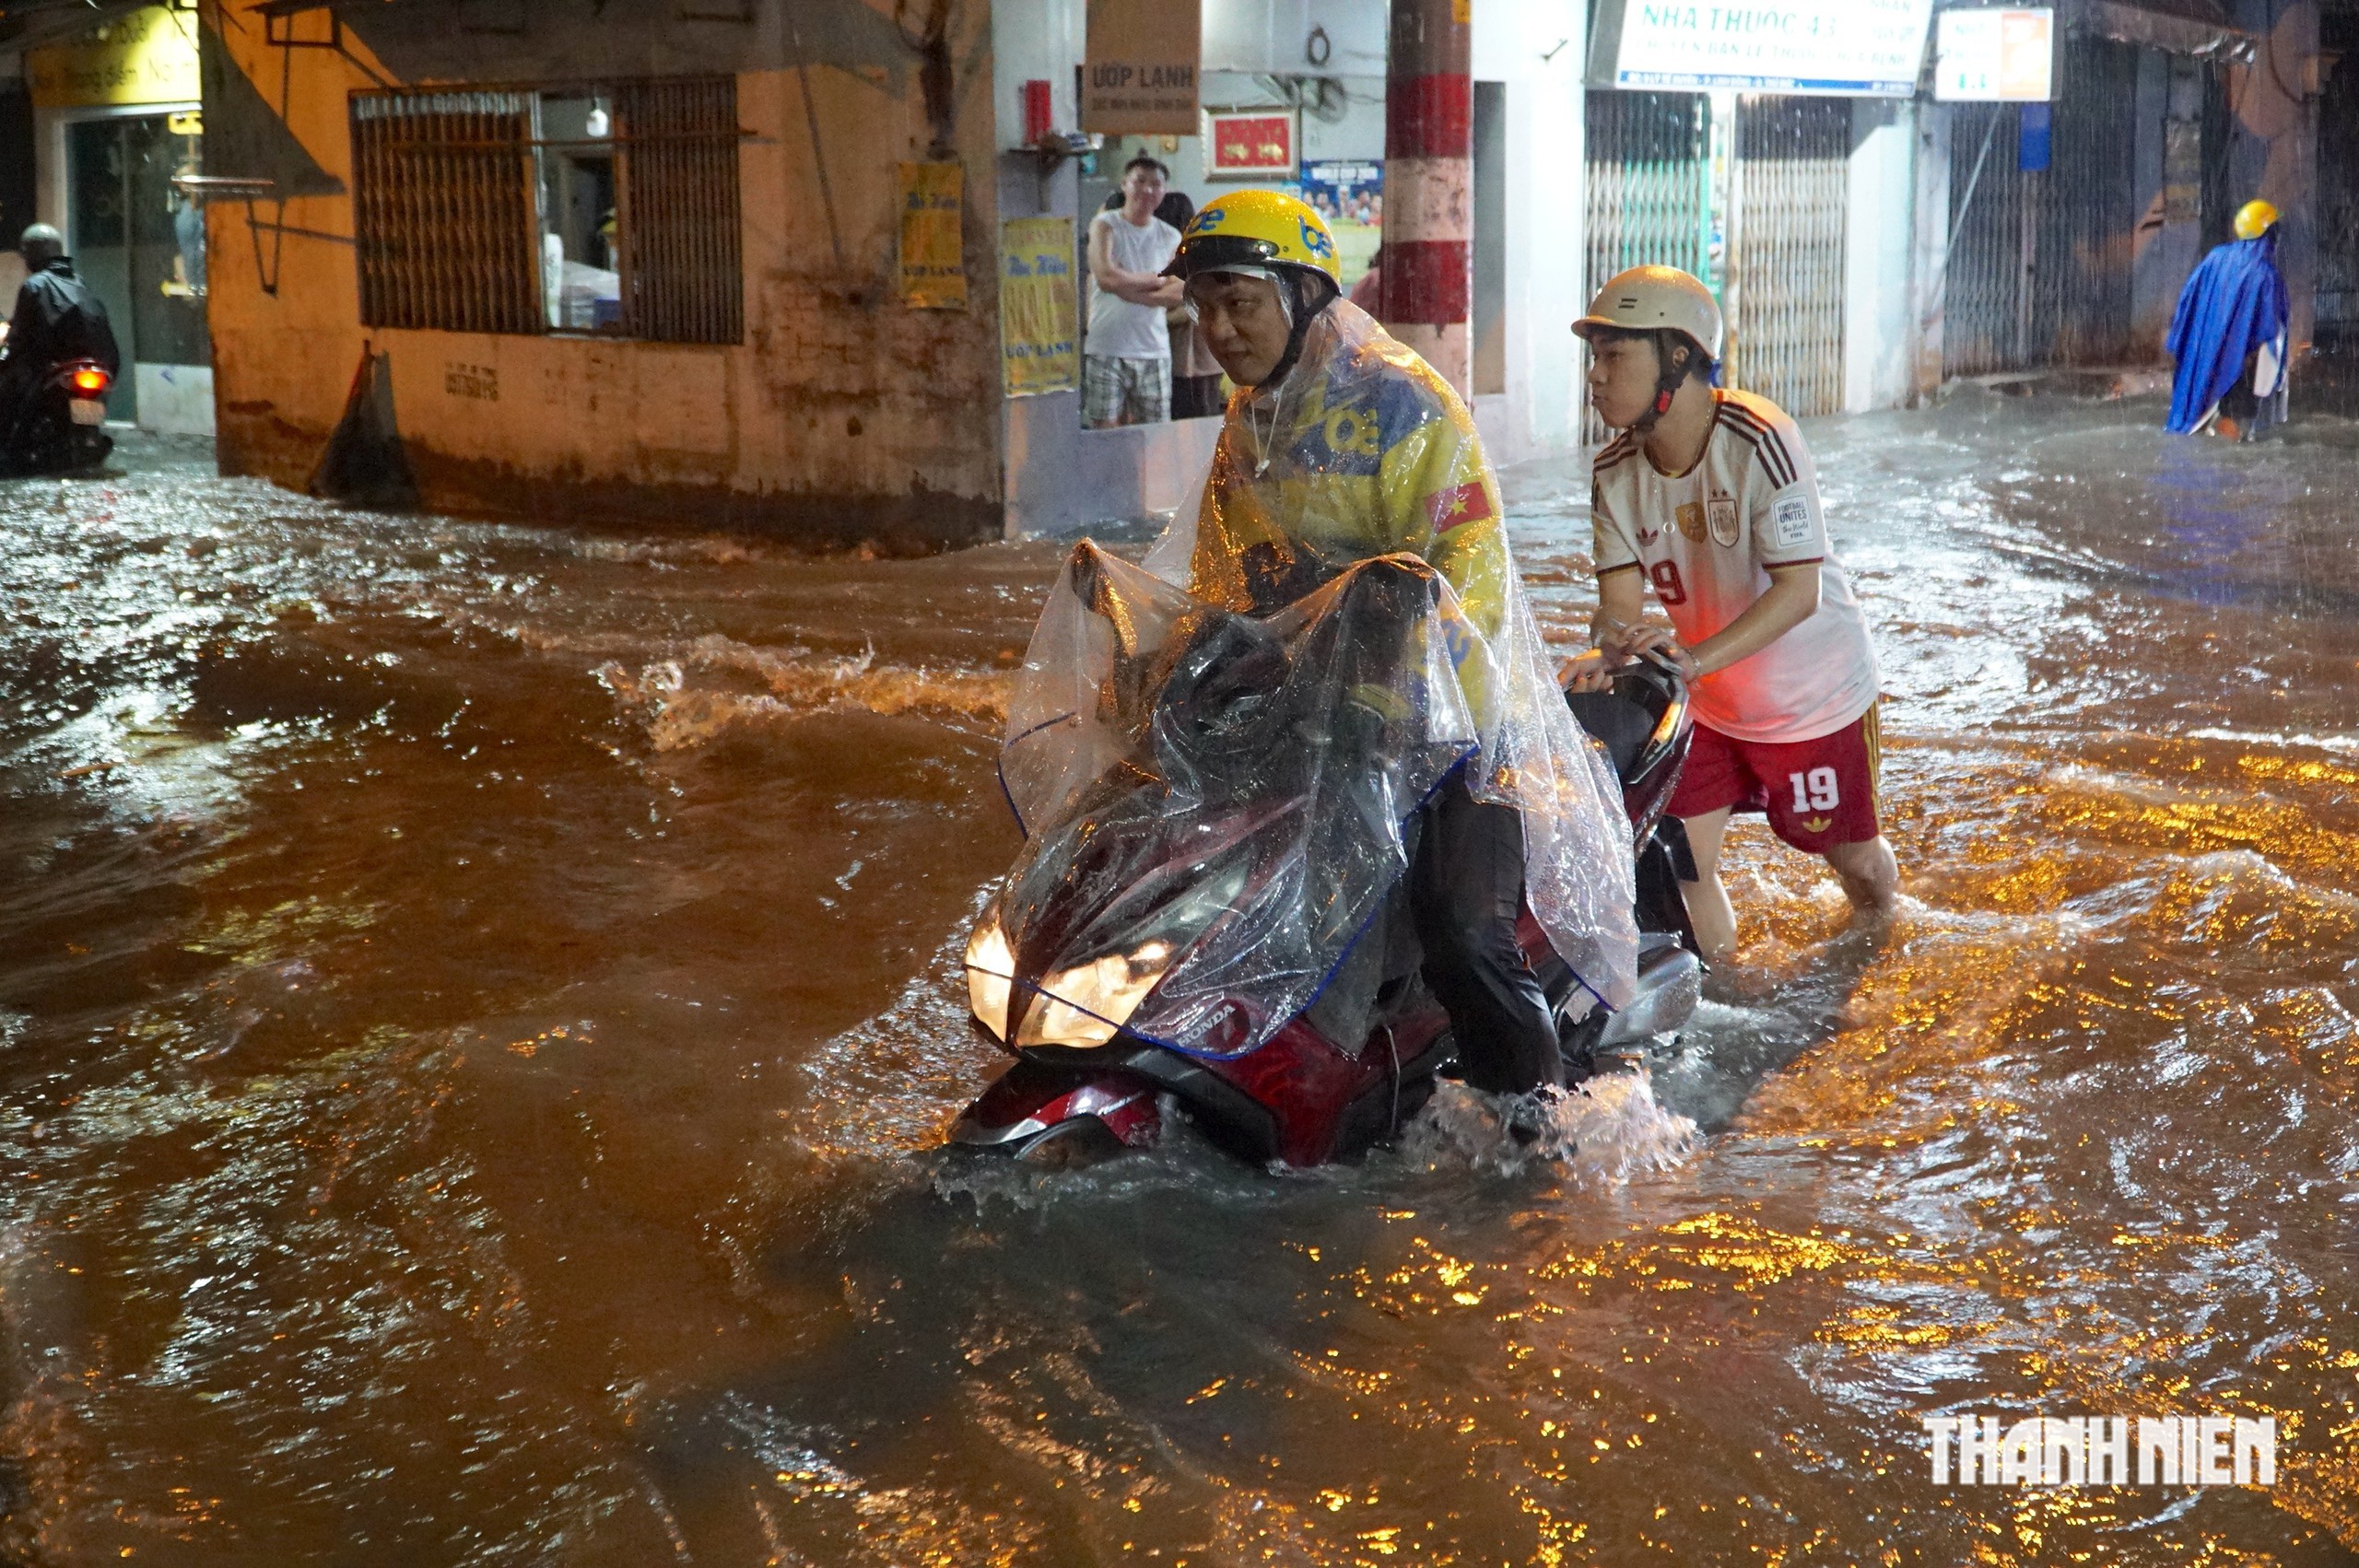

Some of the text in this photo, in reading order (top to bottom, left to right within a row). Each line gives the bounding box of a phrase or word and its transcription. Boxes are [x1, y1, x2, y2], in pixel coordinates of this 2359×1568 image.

[1779, 509, 1808, 523] UNITES
[1789, 766, 1839, 813] 19
[1176, 1004, 1237, 1048] HONDA
